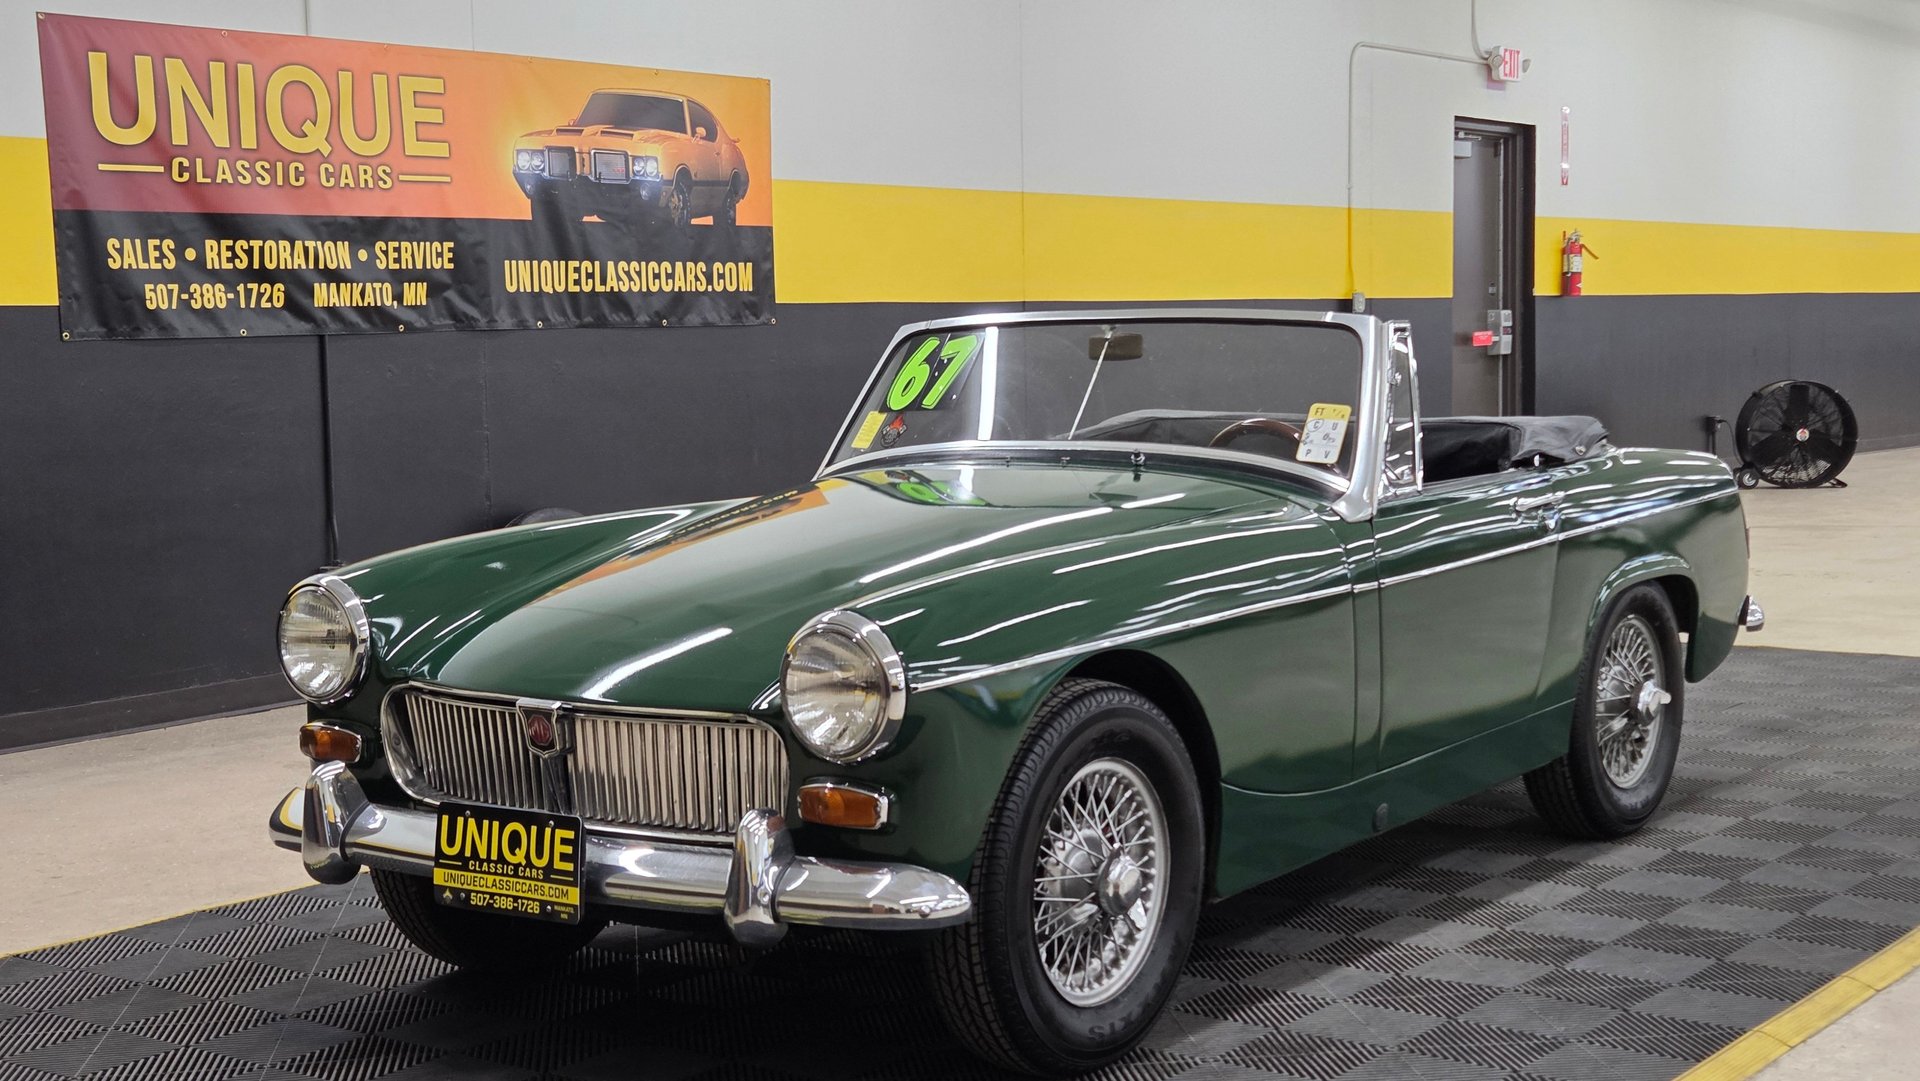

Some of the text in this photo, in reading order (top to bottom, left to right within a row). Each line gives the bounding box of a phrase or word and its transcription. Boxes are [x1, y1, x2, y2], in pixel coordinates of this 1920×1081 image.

[1503, 48, 1520, 79] EXIT
[88, 52, 450, 157] UNIQUE
[171, 157, 393, 189] CLASSIC CARS
[106, 238, 454, 270] SALES RESTORATION SERVICE
[504, 260, 753, 294] UNIQUECLASSICCARS.COM
[145, 282, 427, 310] 507-386-1726 MANKATO, MN
[886, 335, 978, 411] 67
[440, 814, 575, 871] UNIQUE
[468, 860, 544, 879] CLASSIC CARS
[443, 872, 569, 900] UNIQUECLASSICCARS.COM
[470, 892, 540, 914] 507-386-1726
